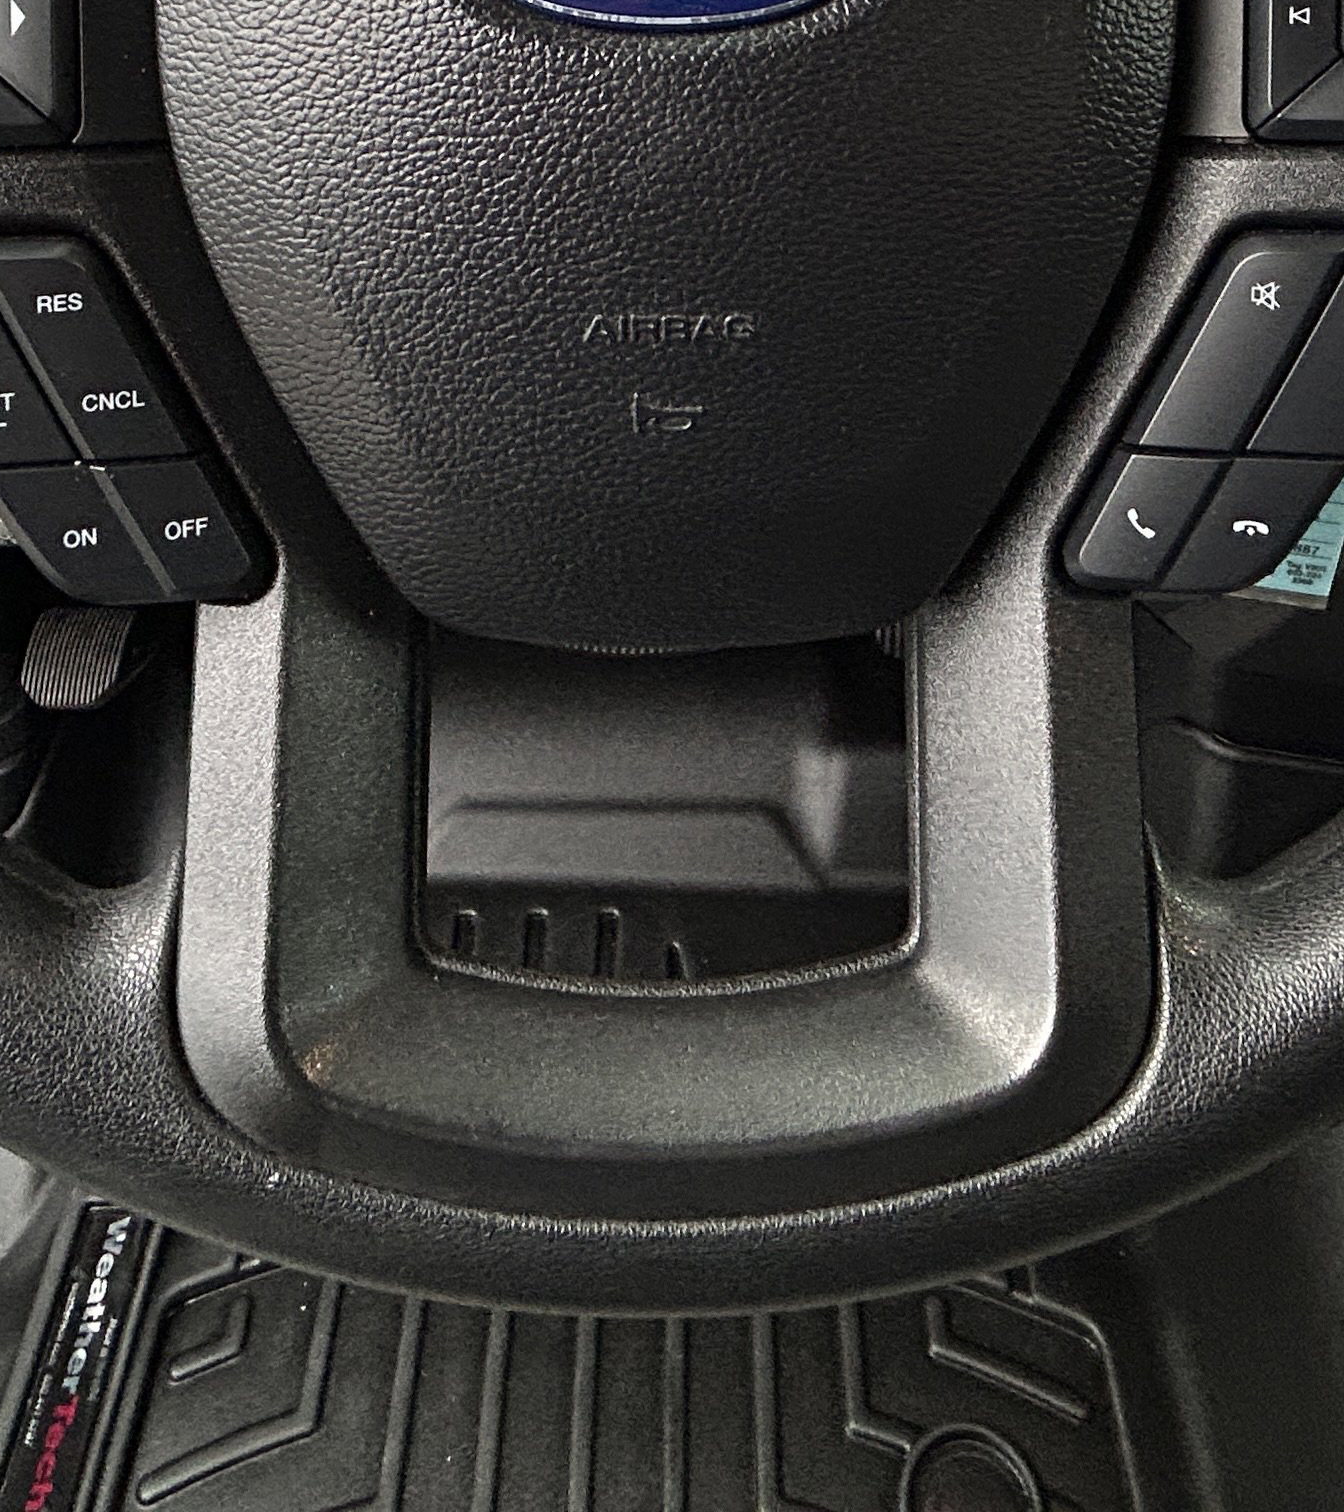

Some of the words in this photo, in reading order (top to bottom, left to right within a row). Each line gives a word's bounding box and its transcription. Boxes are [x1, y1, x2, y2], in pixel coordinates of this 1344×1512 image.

[36, 293, 83, 313] RES
[582, 312, 756, 344] AIRBAG
[81, 390, 146, 413] CNCL
[62, 528, 98, 549] ON
[164, 517, 209, 541] OFF
